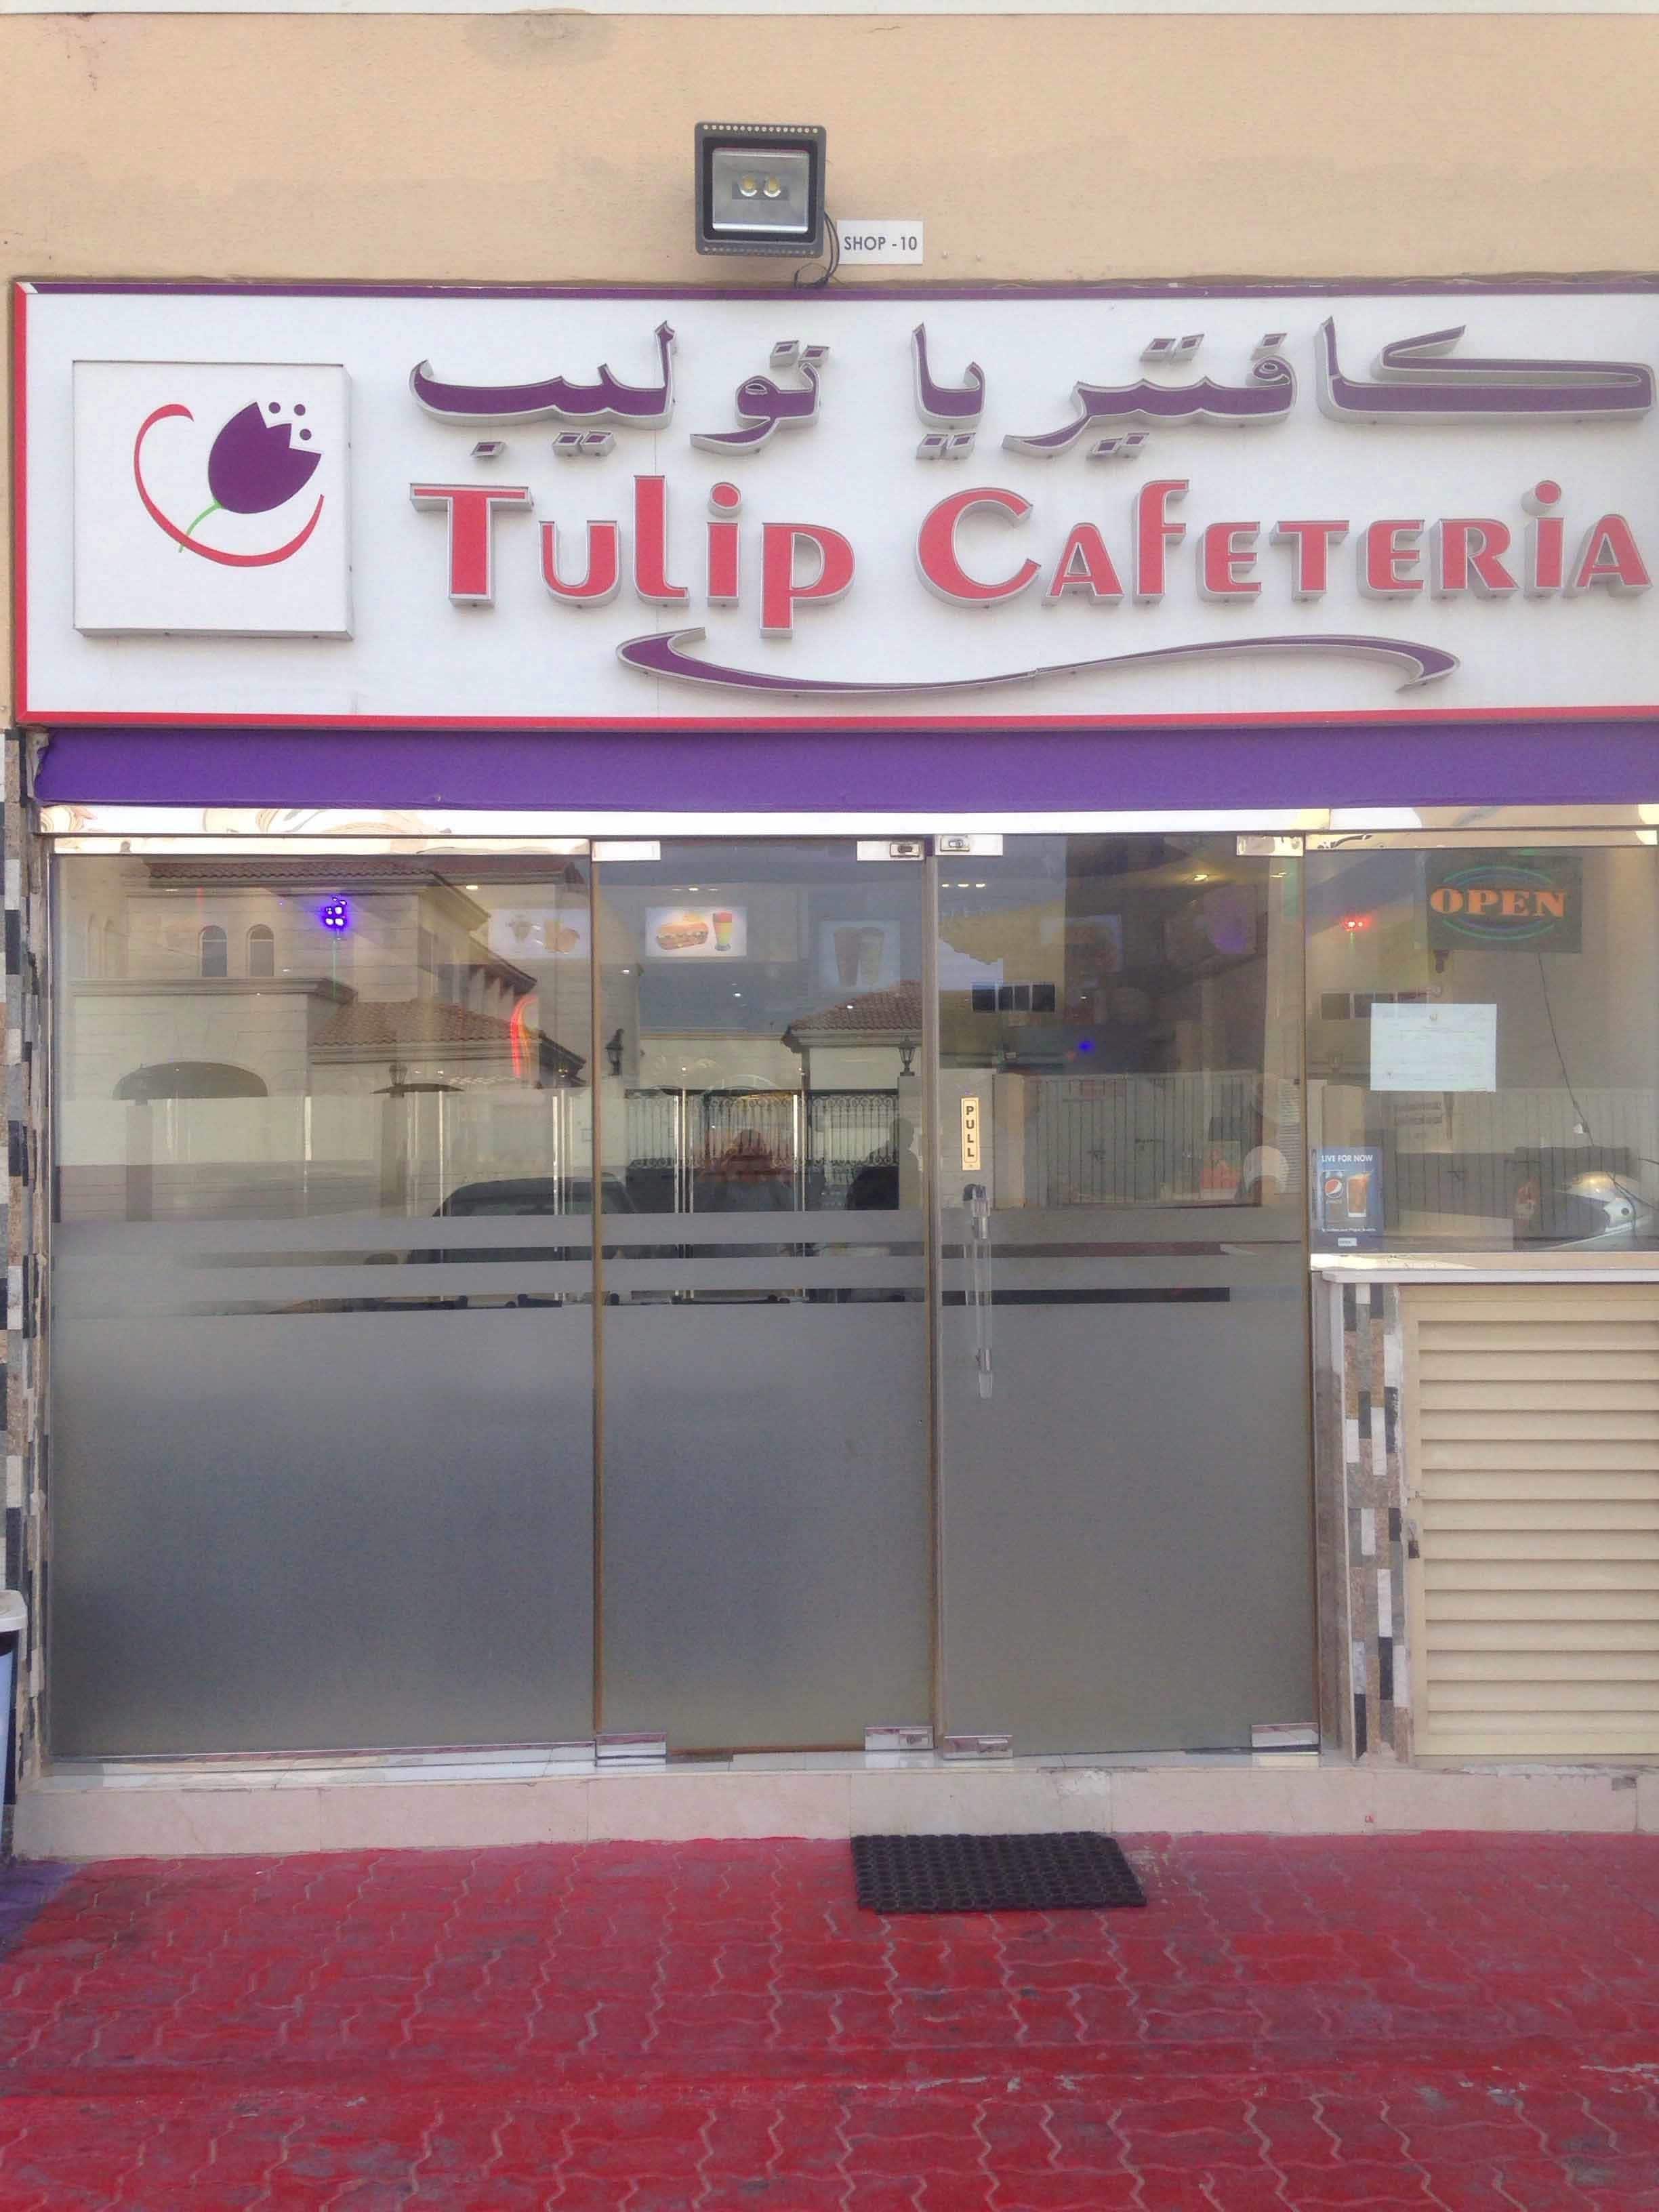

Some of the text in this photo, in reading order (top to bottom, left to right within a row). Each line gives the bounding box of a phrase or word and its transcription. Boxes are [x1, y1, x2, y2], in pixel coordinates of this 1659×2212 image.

[844, 236, 886, 251] SHOP
[409, 316, 1656, 459] كافتيريا توليب
[410, 475, 857, 638] Tulip
[1431, 888, 1566, 917] OPEN
[966, 1105, 975, 1157] PULL
[1338, 1154, 1352, 1162] FOR
